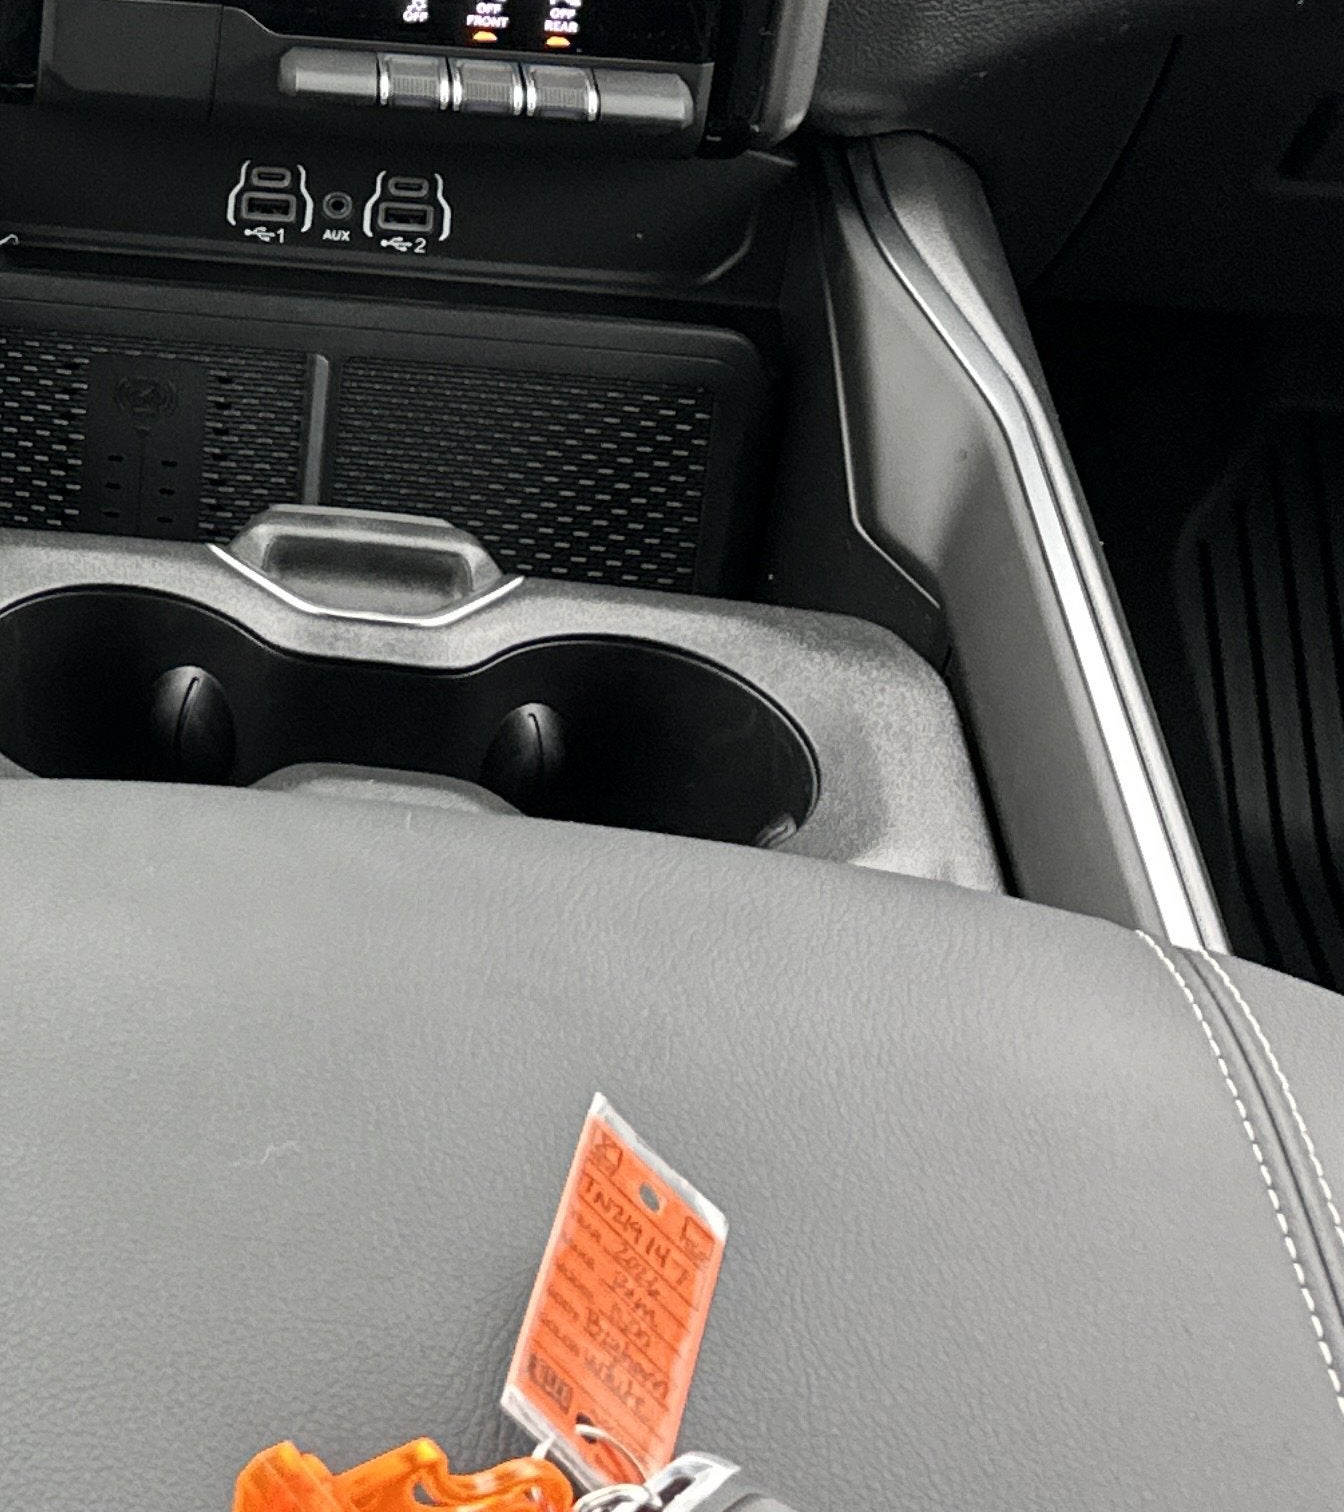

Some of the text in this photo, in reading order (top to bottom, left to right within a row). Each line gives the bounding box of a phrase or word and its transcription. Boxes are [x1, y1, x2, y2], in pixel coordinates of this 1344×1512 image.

[475, 2, 502, 15] OFF
[549, 7, 577, 20] OFF
[402, 10, 430, 23] OFF
[466, 14, 510, 29] FRONT
[543, 19, 580, 34] REAR
[275, 228, 285, 244] 1
[322, 229, 351, 242] AUX
[413, 237, 428, 254] 2
